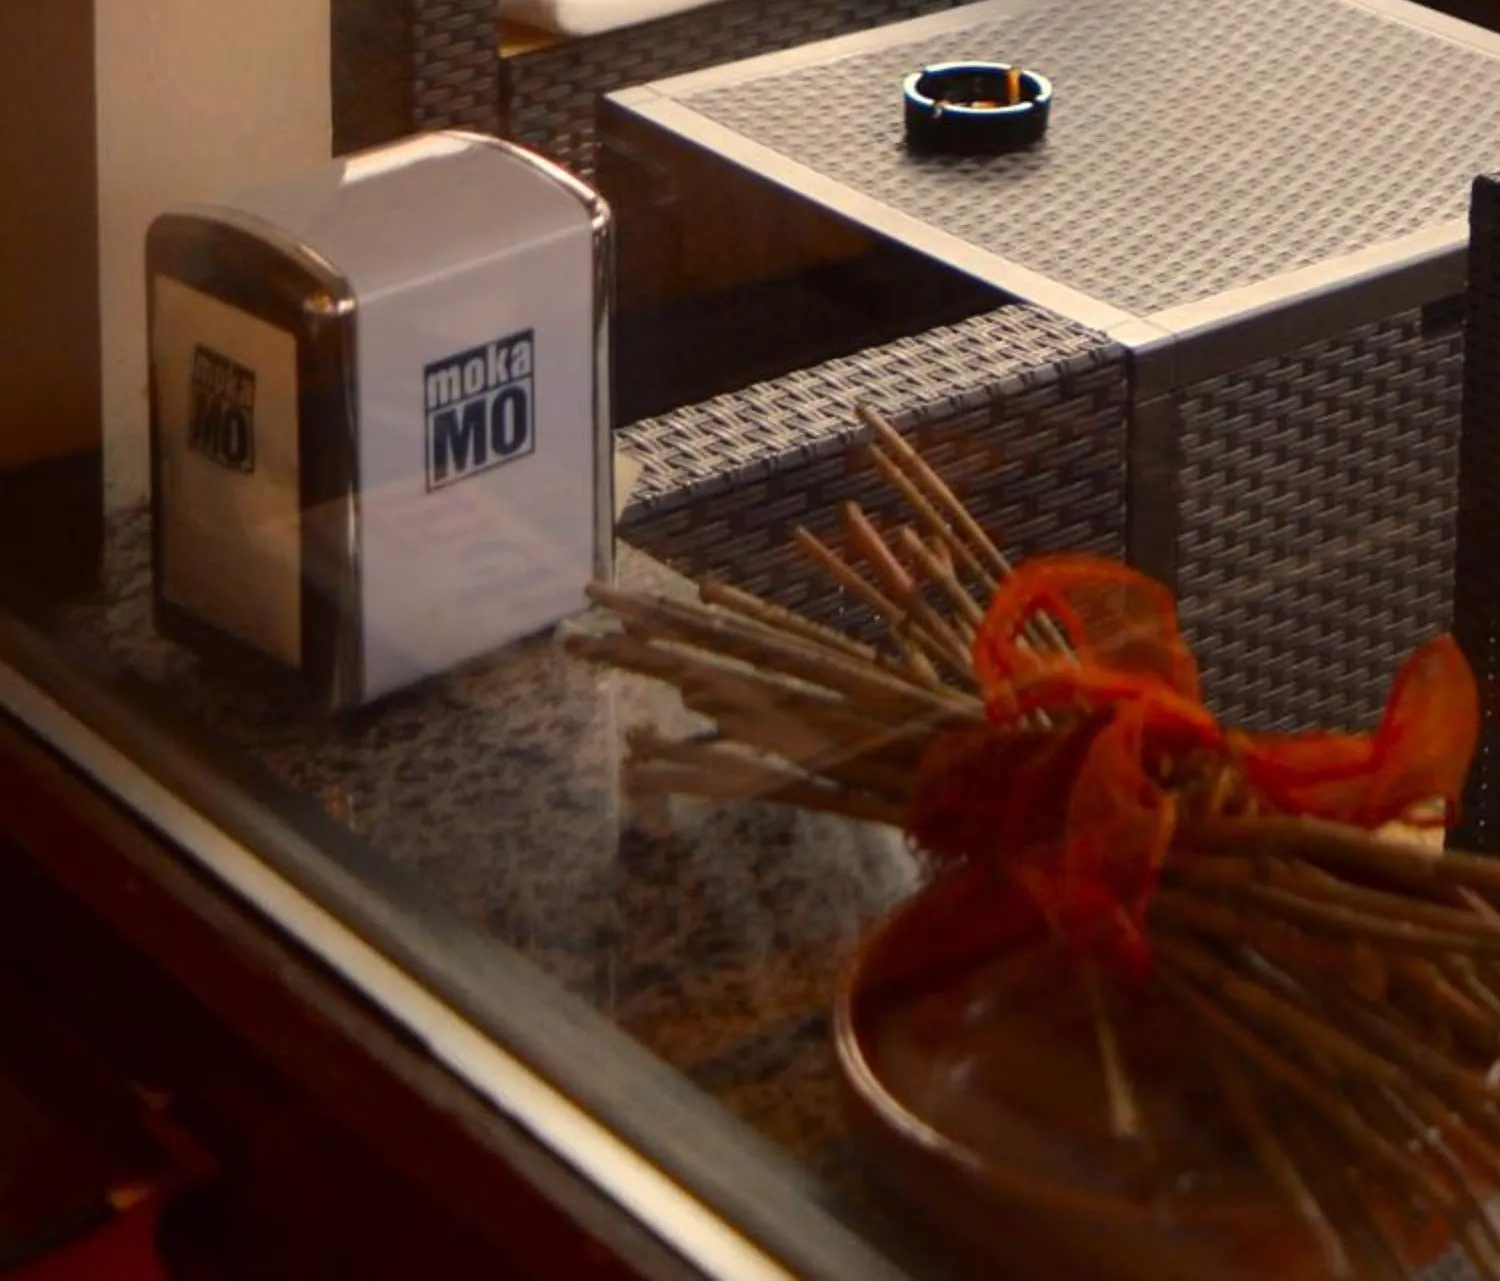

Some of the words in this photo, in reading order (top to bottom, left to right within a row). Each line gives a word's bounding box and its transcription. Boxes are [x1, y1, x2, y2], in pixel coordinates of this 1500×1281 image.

[194, 354, 252, 406] moka
[427, 339, 531, 407] moka
[191, 392, 248, 462] MO
[433, 385, 528, 481] MO
